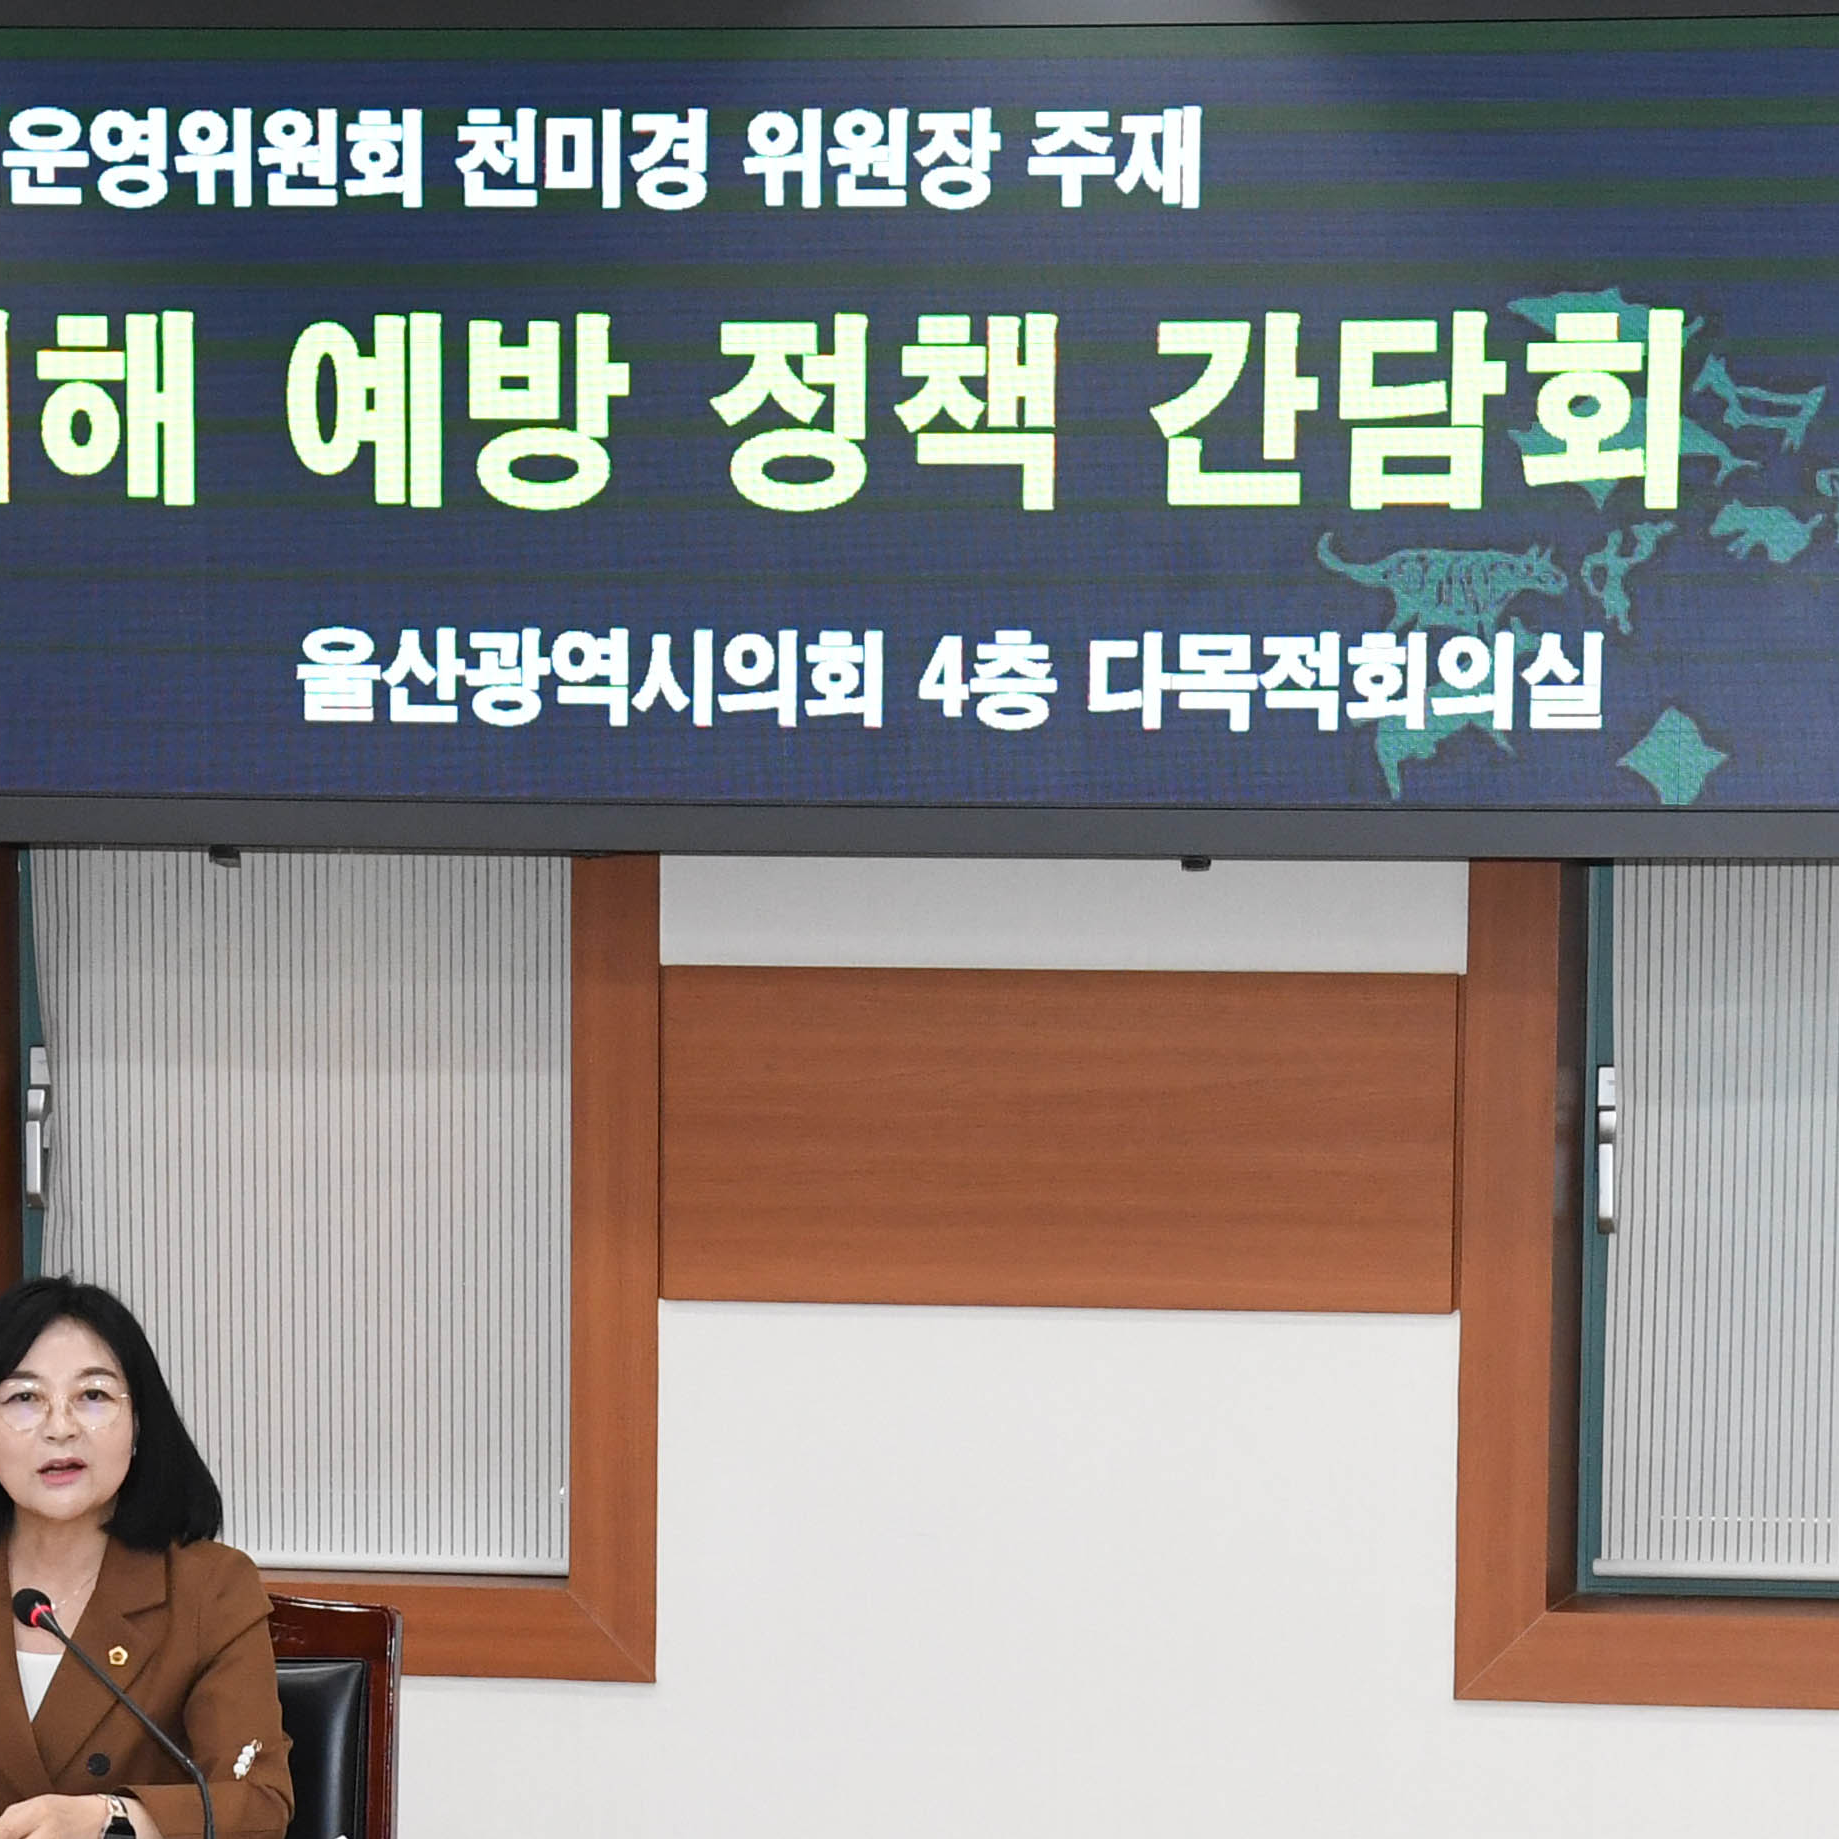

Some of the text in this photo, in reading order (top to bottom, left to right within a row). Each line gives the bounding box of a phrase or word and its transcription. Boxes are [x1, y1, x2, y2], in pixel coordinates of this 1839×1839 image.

[456, 108, 708, 210] 천미경
[743, 107, 1001, 210] 위원장
[1027, 105, 1202, 209] 주재
[286, 312, 629, 510] 예방
[710, 313, 1058, 512] 정책
[1150, 309, 1684, 509] 간담회
[296, 627, 1604, 732] 울산광역시의회 4층 다목적회의실
